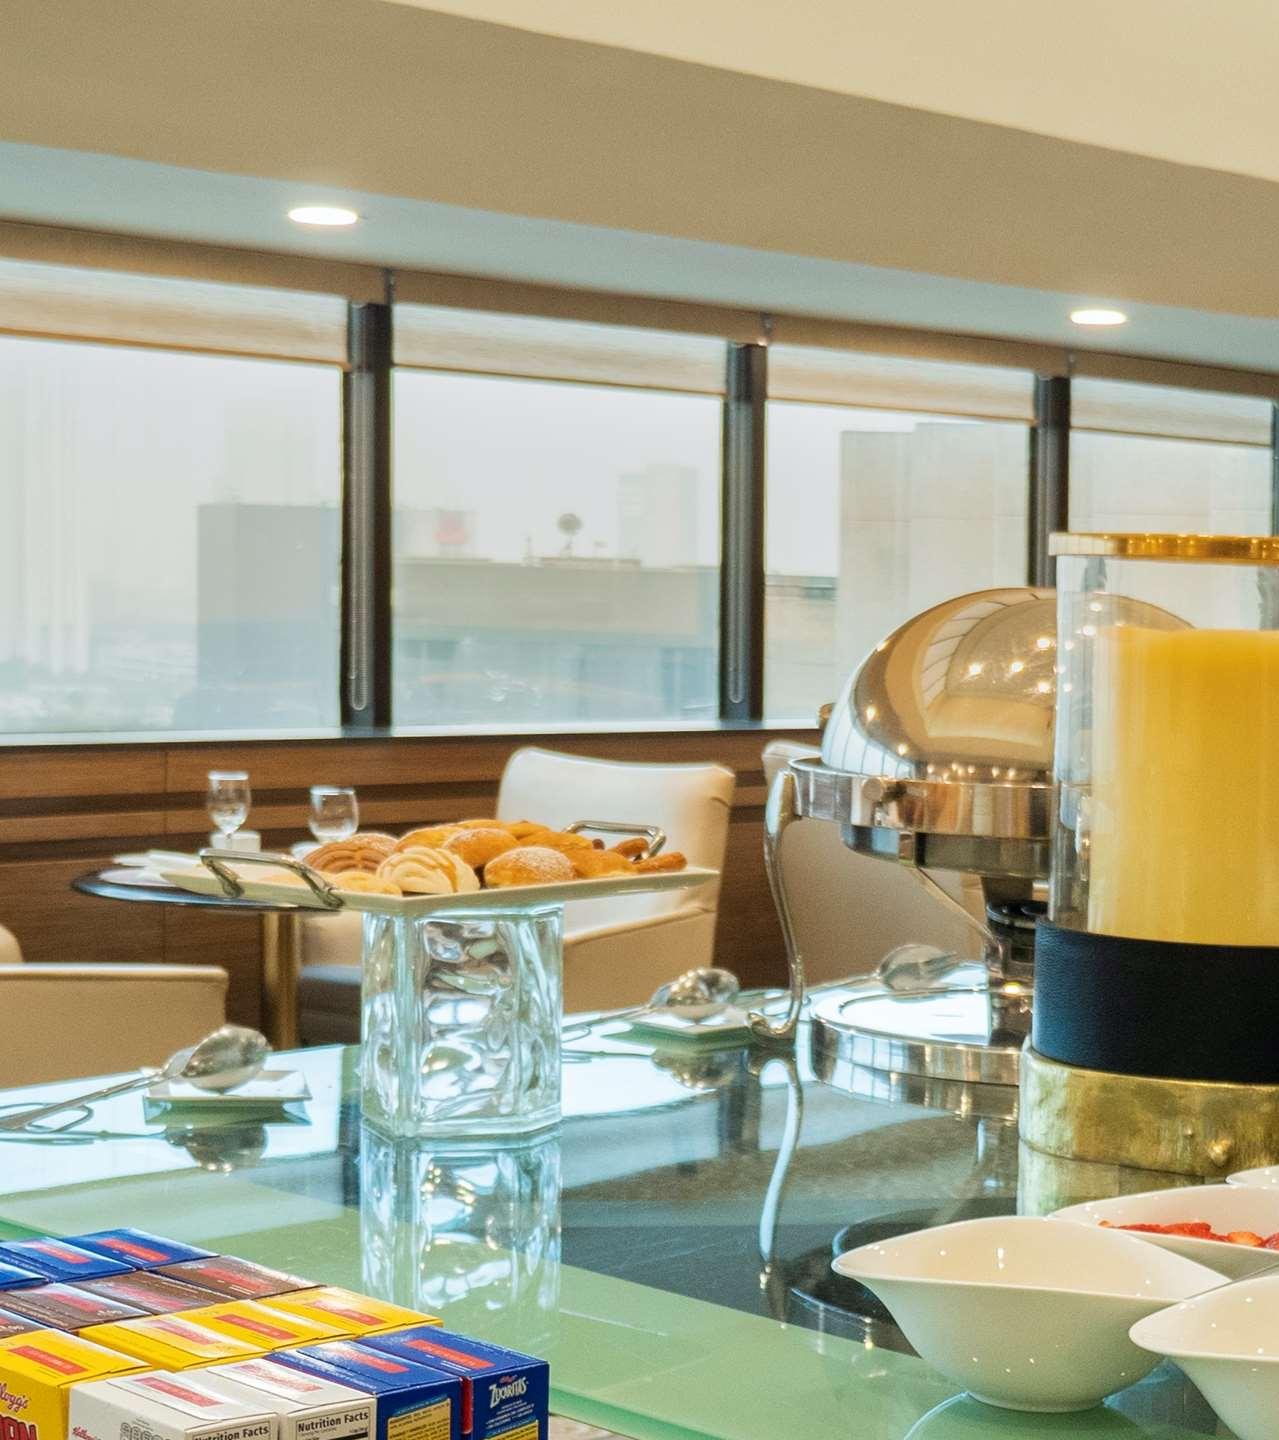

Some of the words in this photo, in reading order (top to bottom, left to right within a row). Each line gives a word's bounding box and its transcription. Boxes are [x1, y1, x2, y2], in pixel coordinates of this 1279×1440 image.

[298, 1417, 342, 1433] Nutrition
[344, 1411, 369, 1424] Facts
[242, 1425, 269, 1439] Facts
